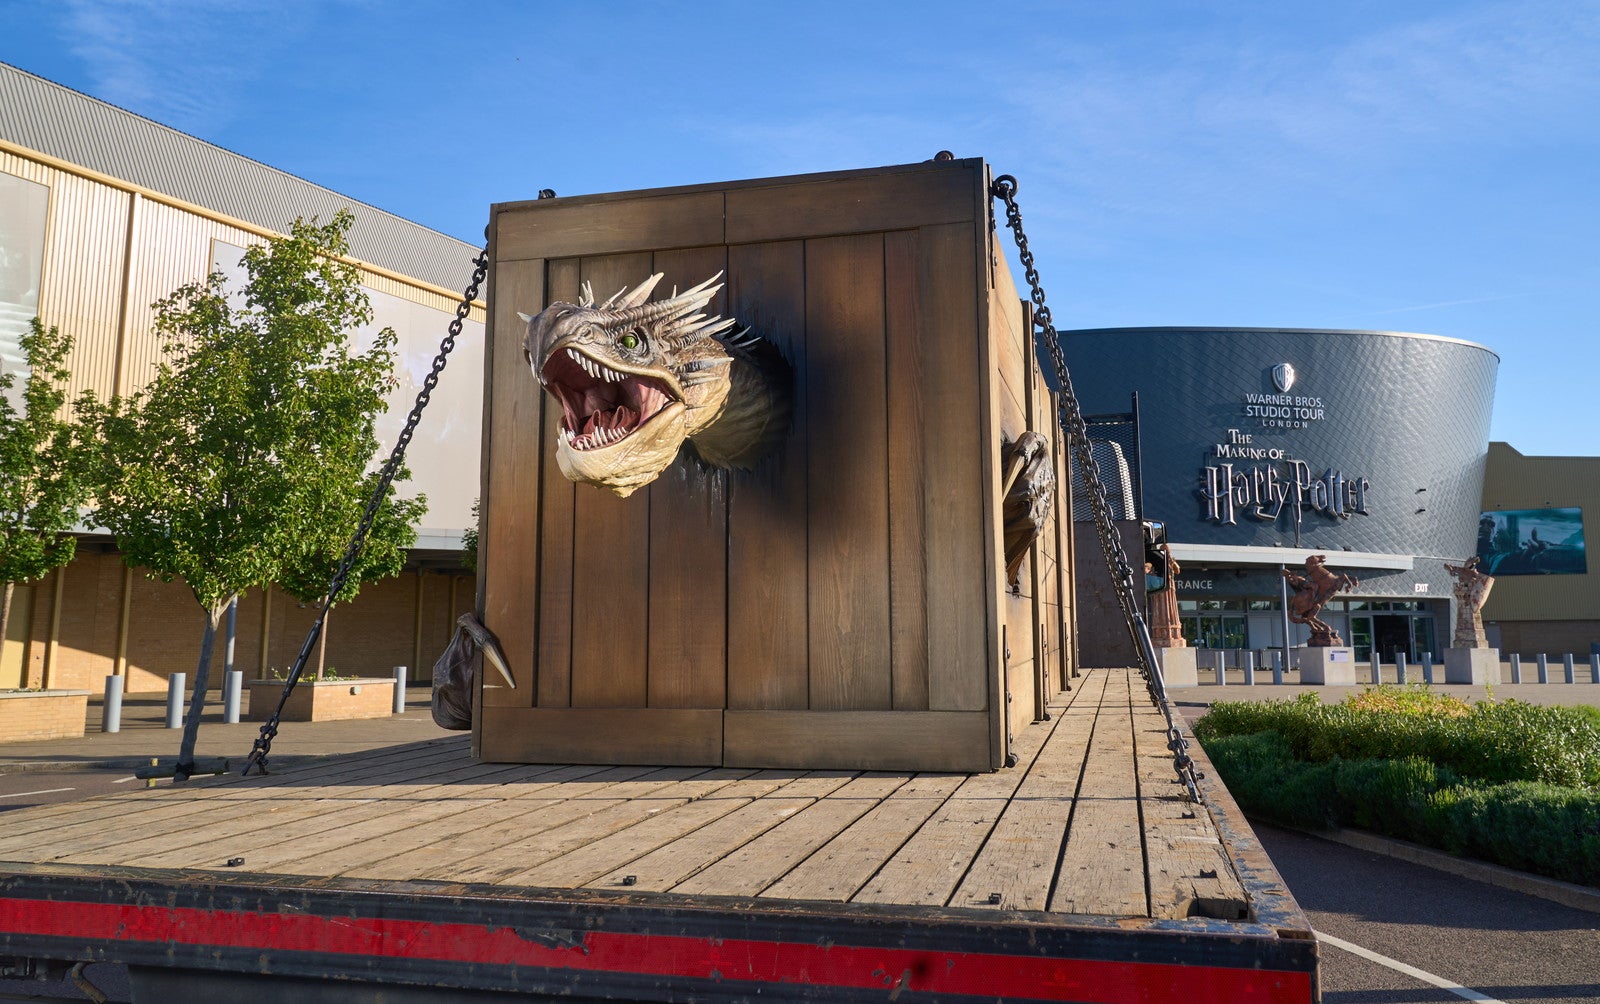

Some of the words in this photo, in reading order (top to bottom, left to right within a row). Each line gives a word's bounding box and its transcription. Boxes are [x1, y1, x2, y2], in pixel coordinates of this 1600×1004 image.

[1246, 393, 1293, 406] WARNER
[1295, 396, 1325, 408] BROS.
[1246, 405, 1291, 418] STUDIO
[1293, 407, 1325, 420] TOUR
[1262, 419, 1308, 428] LONDON
[1228, 429, 1252, 444] THE
[1216, 444, 1266, 460] MAKING
[1268, 448, 1285, 460] OF
[1201, 463, 1290, 525] Harry
[1286, 459, 1370, 546] Potter
